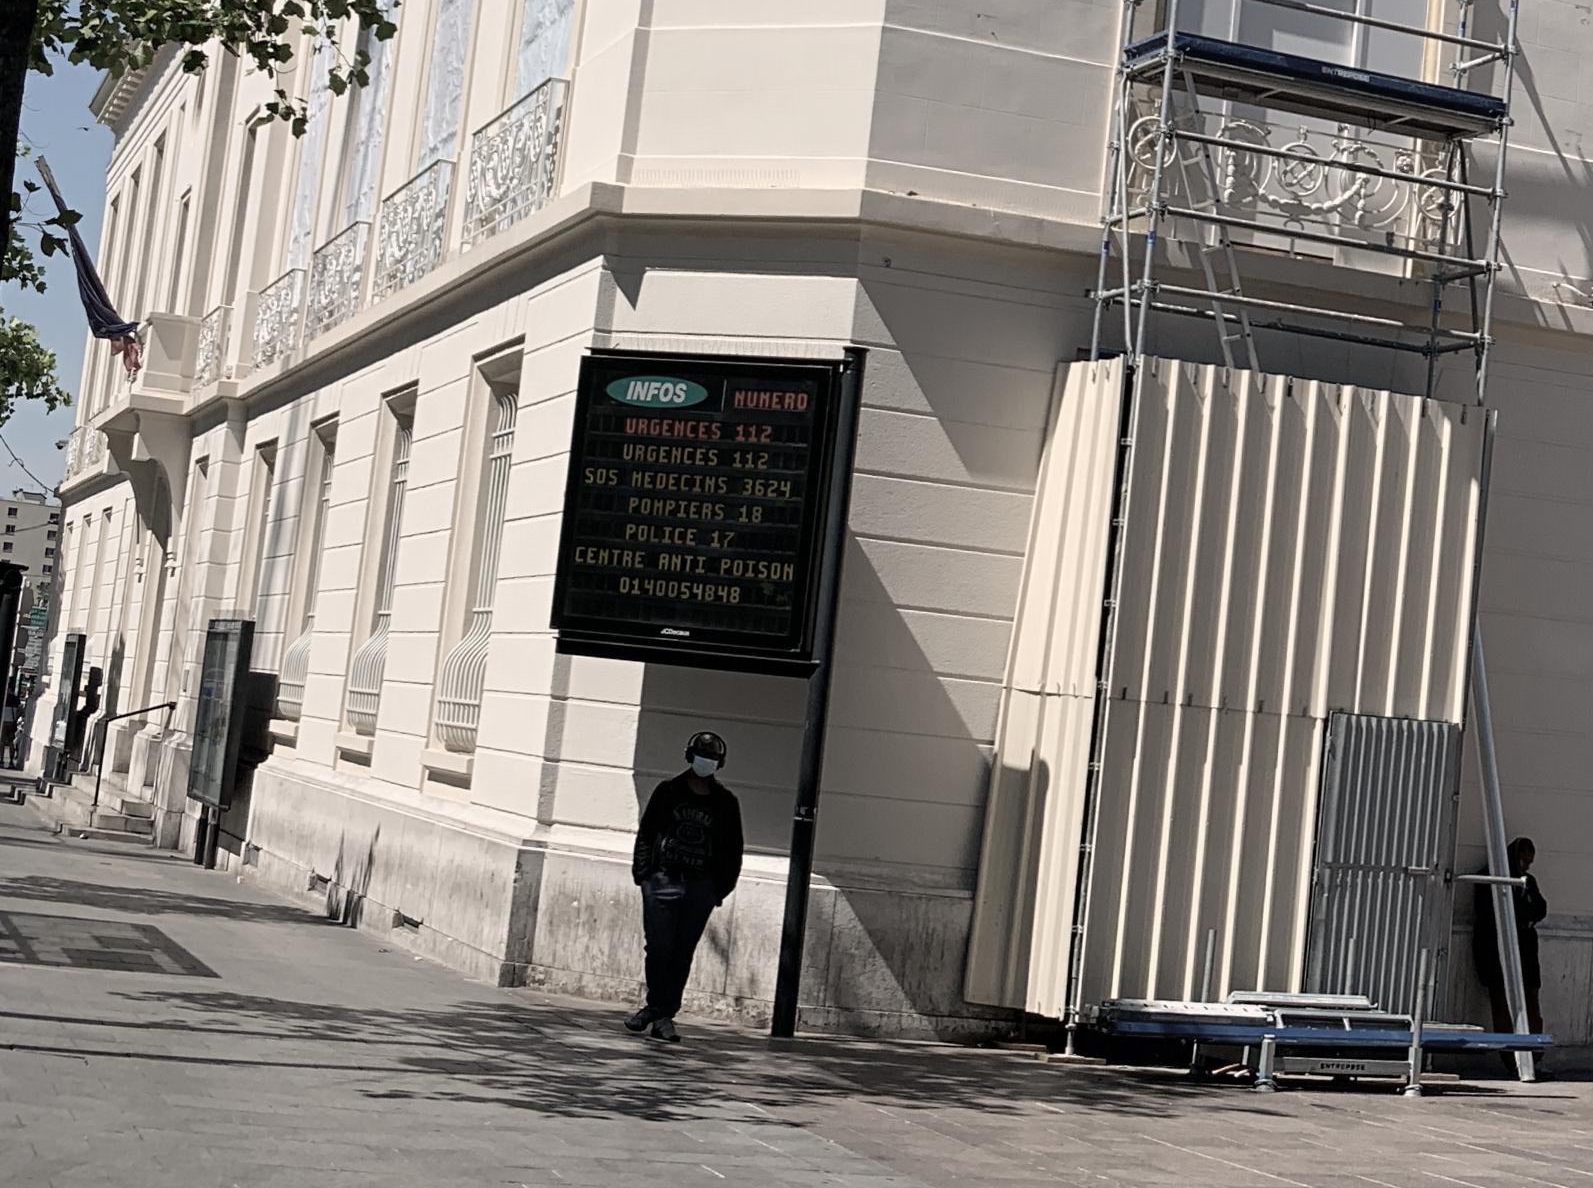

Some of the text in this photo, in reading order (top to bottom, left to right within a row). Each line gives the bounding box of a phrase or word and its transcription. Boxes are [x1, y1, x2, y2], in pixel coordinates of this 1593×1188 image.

[625, 380, 688, 403] INFOS
[734, 390, 808, 410] NUMERO
[626, 417, 772, 443] URGENCES 112
[623, 444, 768, 469] URGENCES 112
[584, 467, 791, 498] SOS MEDECINS 3624
[628, 497, 762, 523] POMPIERS 18
[625, 523, 735, 548] POLICE 17
[575, 546, 793, 580] CENTRE ANTI POISON
[619, 576, 740, 603] 0140054848
